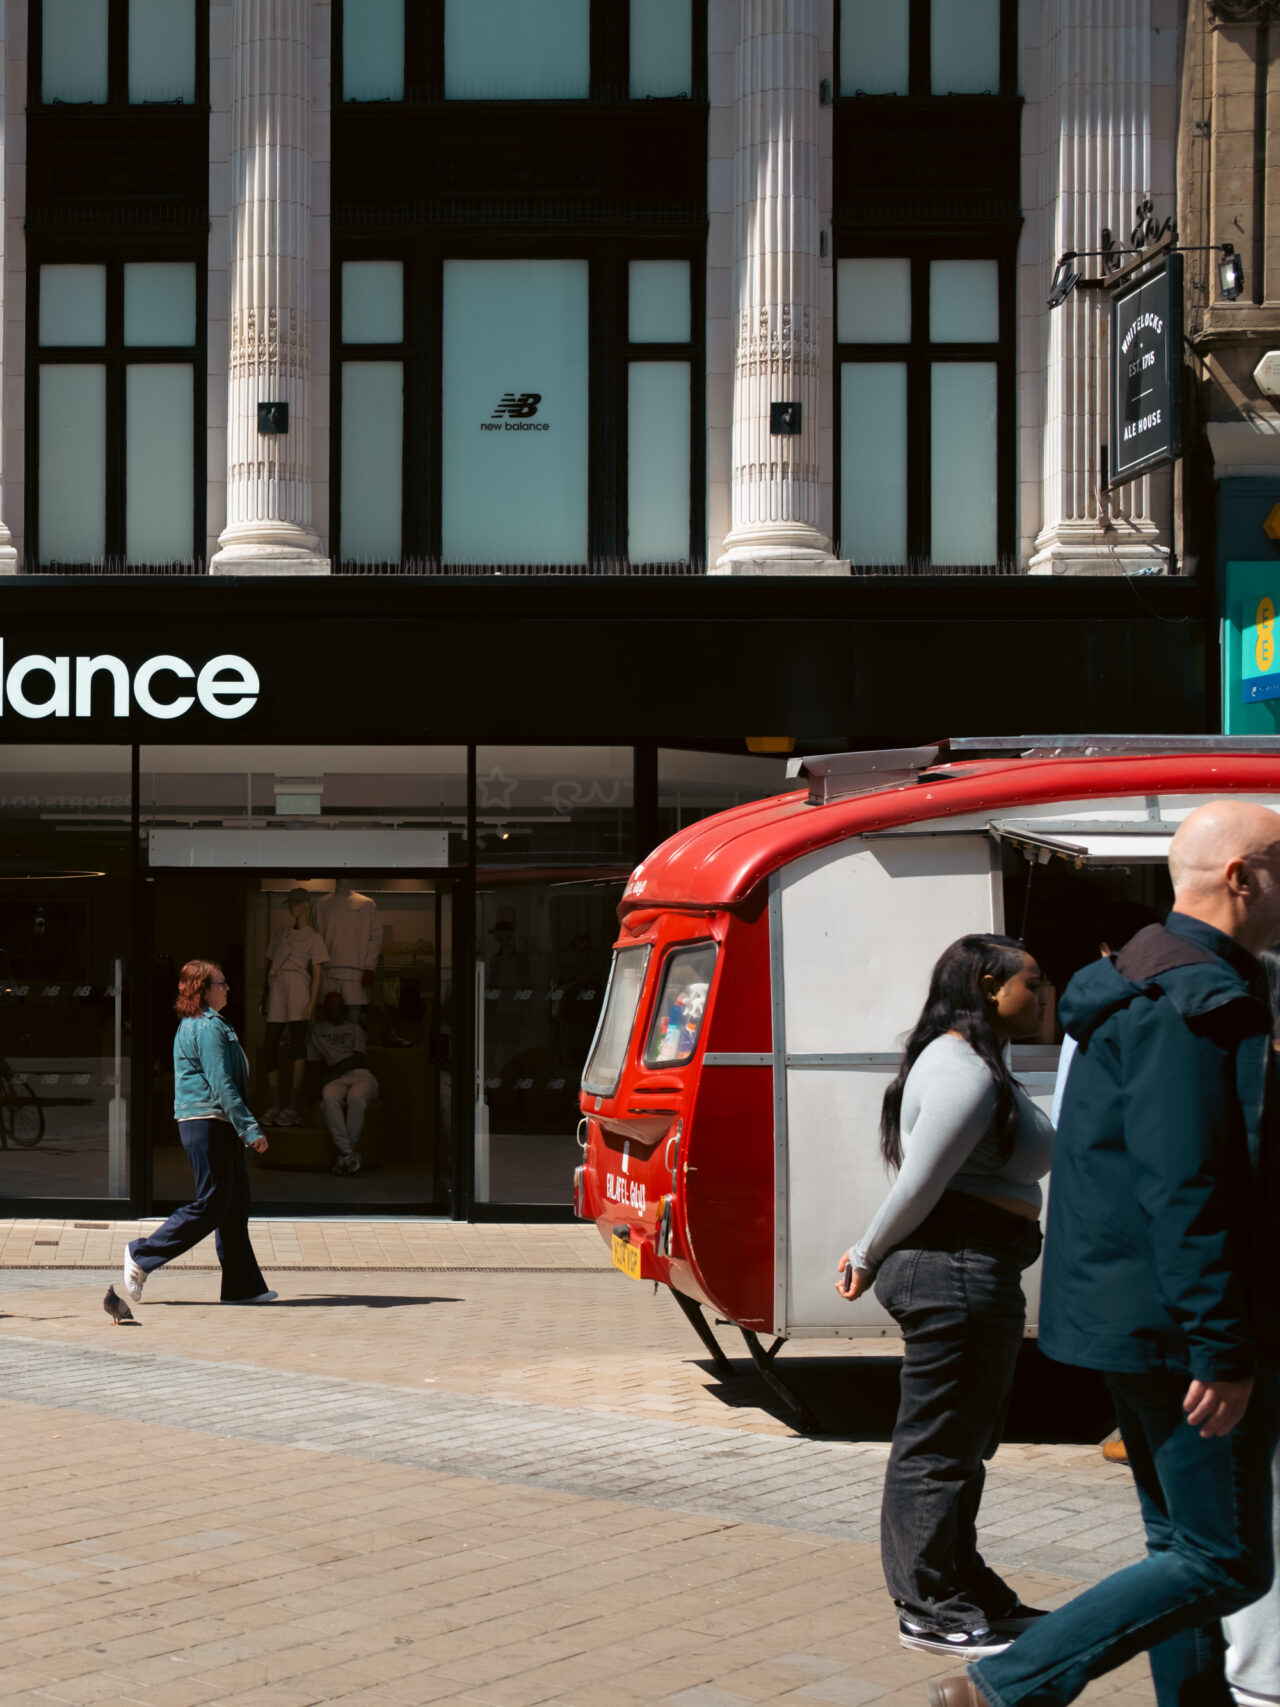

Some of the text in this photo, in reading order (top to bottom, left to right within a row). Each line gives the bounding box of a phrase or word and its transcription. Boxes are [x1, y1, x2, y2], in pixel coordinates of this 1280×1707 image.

[1120, 311, 1164, 355] WHITELOCKS
[480, 421, 550, 431] new balance
[1123, 409, 1162, 441] ALE HOUSE
